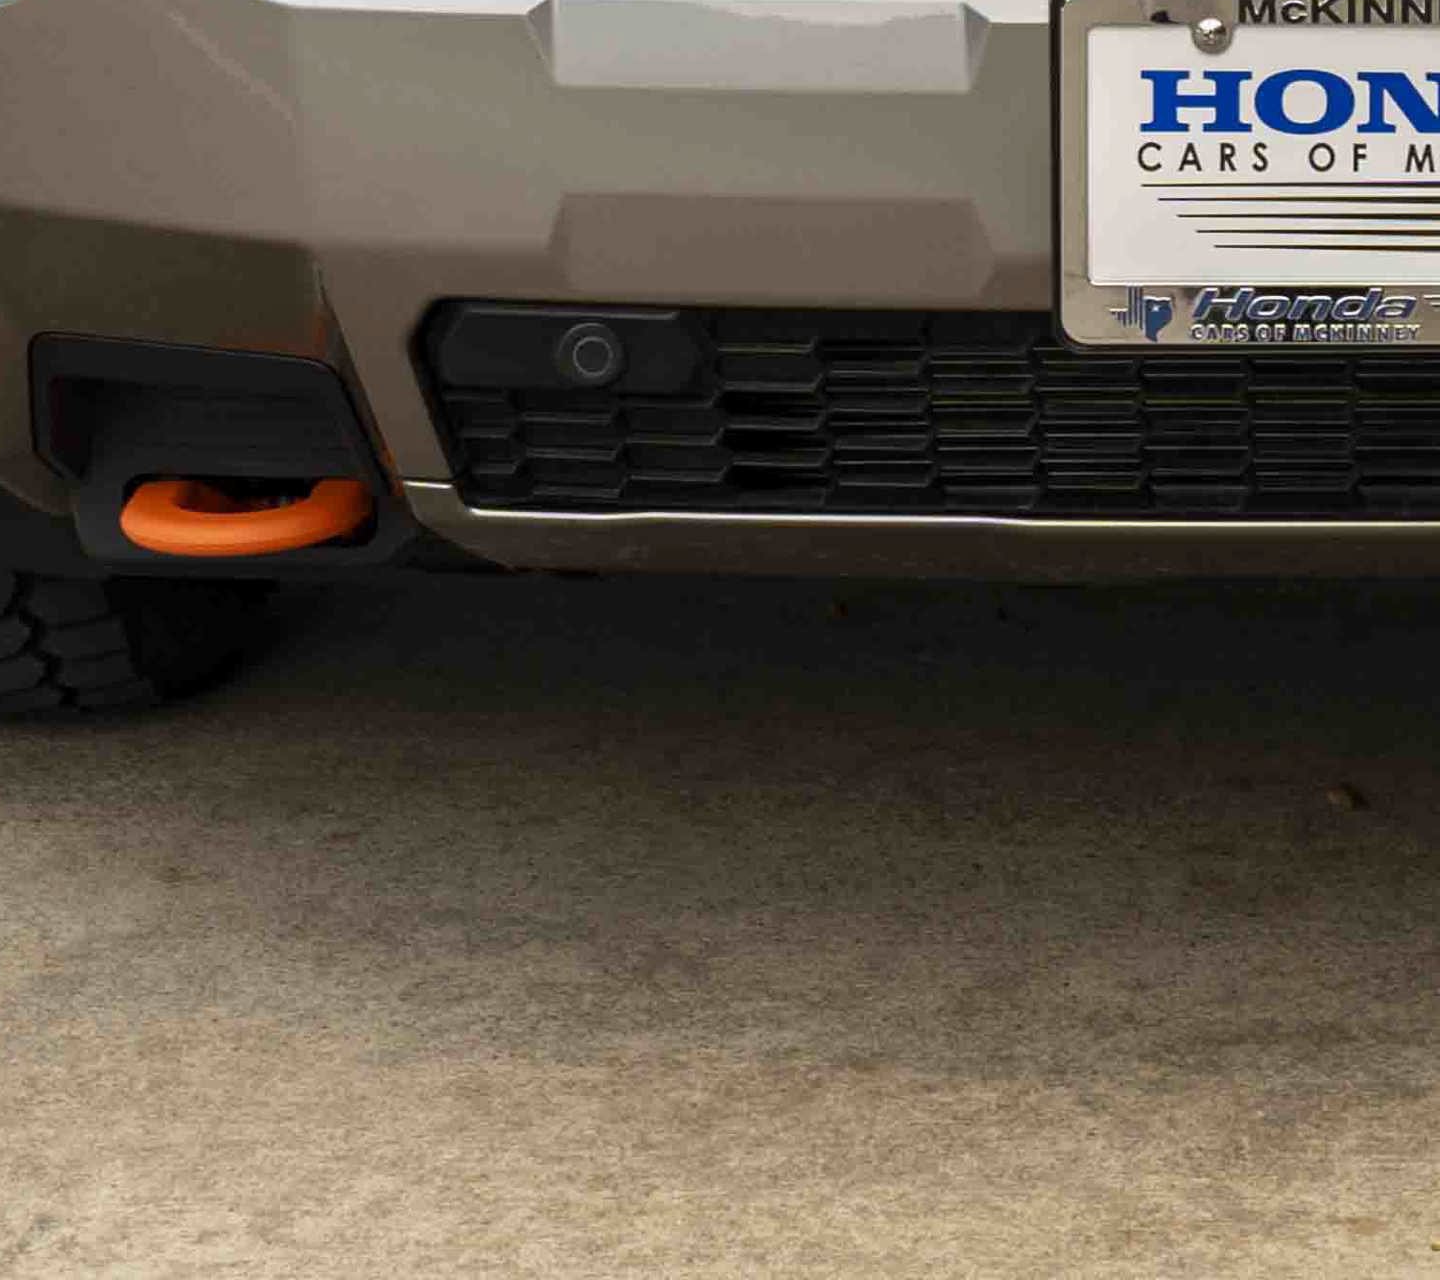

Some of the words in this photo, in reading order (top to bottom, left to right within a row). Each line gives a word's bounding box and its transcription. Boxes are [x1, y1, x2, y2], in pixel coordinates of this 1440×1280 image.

[1137, 141, 1270, 173] CARS
[1308, 141, 1370, 173] OF
[1191, 287, 1417, 322] Honda
[1190, 323, 1249, 342] CARS
[1255, 323, 1287, 342] OF
[1294, 323, 1422, 342] MCKINNEY
